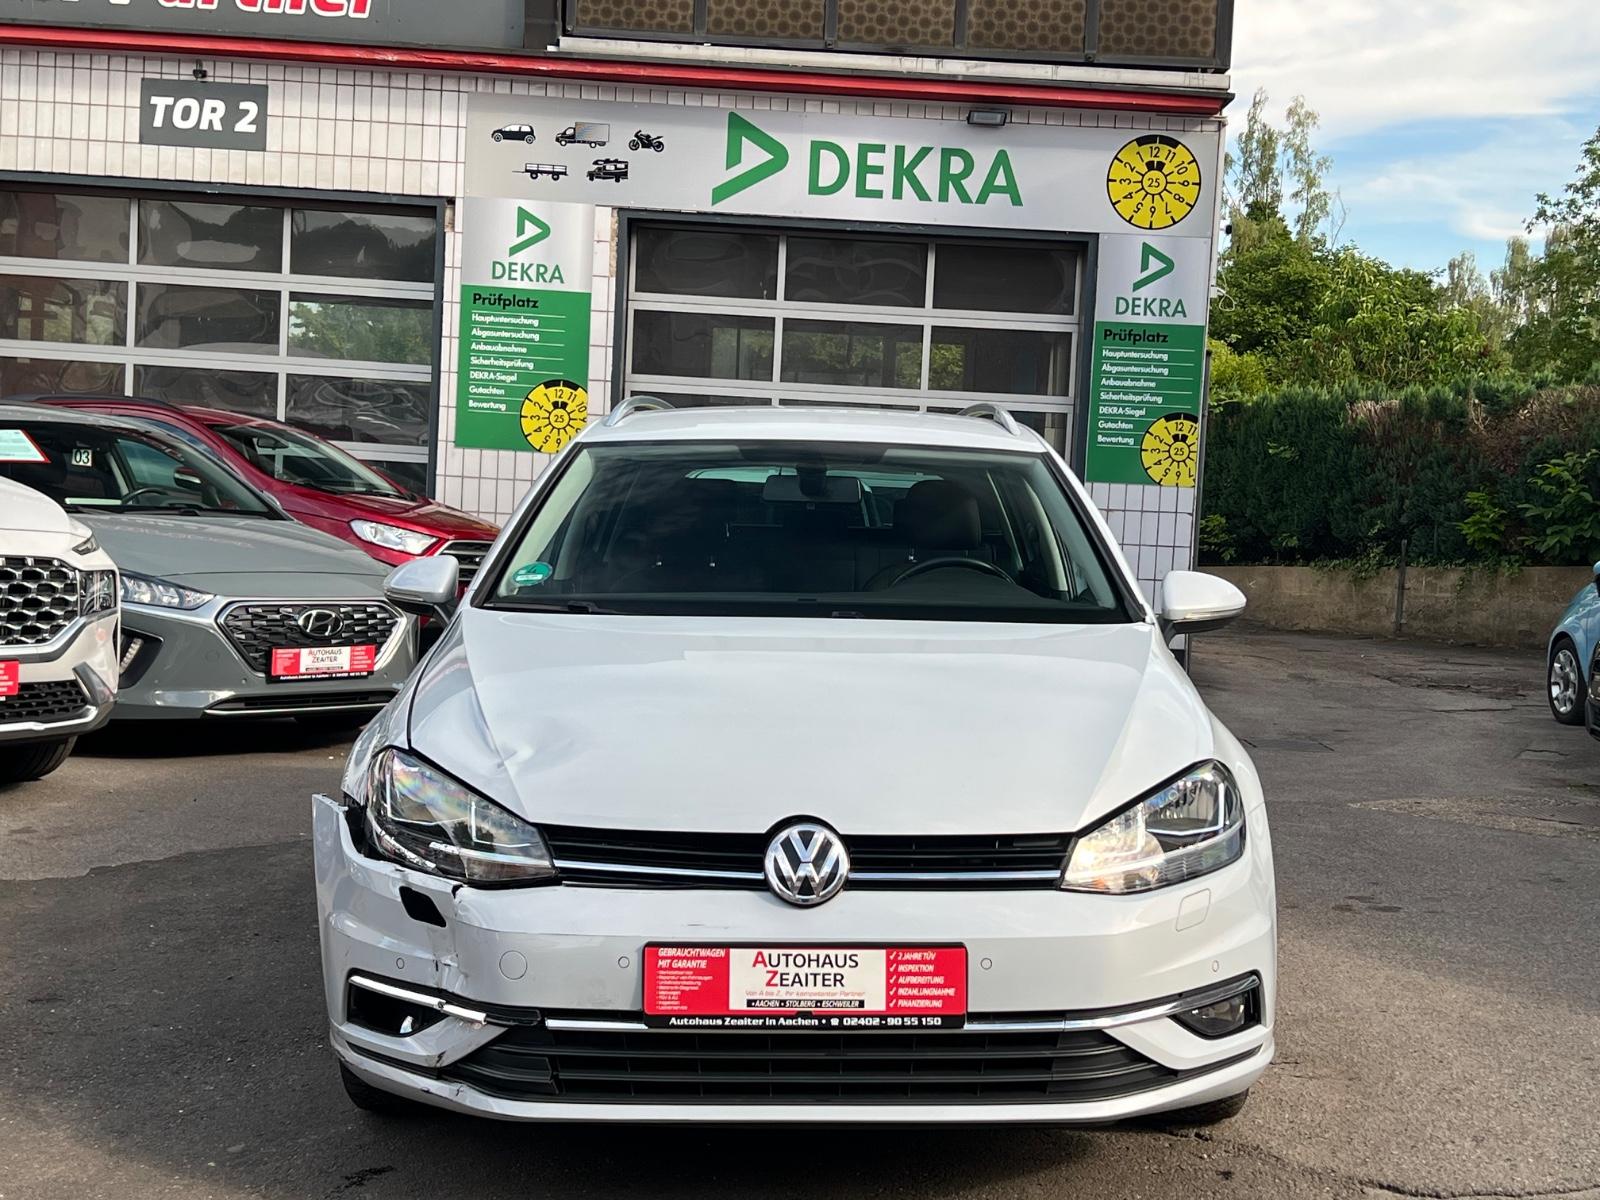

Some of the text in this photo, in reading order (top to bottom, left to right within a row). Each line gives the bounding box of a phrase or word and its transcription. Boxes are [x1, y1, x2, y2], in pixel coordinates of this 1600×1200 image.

[150, 96, 258, 133] TOR 2
[1136, 151, 1144, 162] 1
[1149, 146, 1160, 158] 12
[1165, 150, 1176, 163] 11
[1123, 162, 1136, 173] 2
[1174, 161, 1188, 175] 10
[808, 140, 1024, 207] DEKRA
[1147, 178, 1160, 188] 25
[1122, 191, 1133, 199] 4
[1174, 194, 1185, 203] 8
[1133, 202, 1144, 214] 5
[491, 261, 565, 284] DEKRA
[473, 293, 539, 310] Prüfplatz
[1115, 296, 1187, 318] DEKRA
[472, 313, 539, 327] Hauptuntersuchung
[471, 327, 540, 341] Abgasuntersuchung
[1104, 329, 1169, 345] Prüfplatz
[470, 342, 527, 354] Anbauabnahme
[1102, 349, 1169, 361] Hauptuntersuchung
[1101, 363, 1169, 376] Abgasuntersuchung
[470, 371, 518, 382] DEKRA-Siegel
[1100, 377, 1156, 388] Anbauabnahme
[469, 385, 505, 396] Gutachten
[554, 389, 564, 399] 12
[468, 400, 506, 411] Bewertung
[1099, 406, 1146, 417] DEKRA-Siegel
[554, 415, 564, 423] 25
[1098, 420, 1134, 430] Gutachten
[1174, 422, 1184, 432] 12
[1097, 434, 1135, 445] Bewertung
[74, 449, 90, 465] 03
[1173, 447, 1184, 456] 25
[769, 828, 844, 900] VW
[658, 948, 726, 958] GEBRAUCHTWAGEN
[657, 959, 707, 969] MIT GARANTIE
[752, 951, 859, 968] AUTOHAUS
[898, 964, 934, 972] INSPEKTION
[765, 970, 844, 987] ZEAITER
[785, 1000, 816, 1008] STOLBERG
[822, 1000, 859, 1008] ESCHWEILER
[669, 1017, 722, 1026] Autohaus
[766, 1017, 776, 1026] in
[778, 1017, 818, 1026] Aachen
[843, 1017, 880, 1026] 02402
[887, 1017, 902, 1026] 90
[904, 1017, 918, 1026] 55
[922, 1017, 941, 1026] 150
